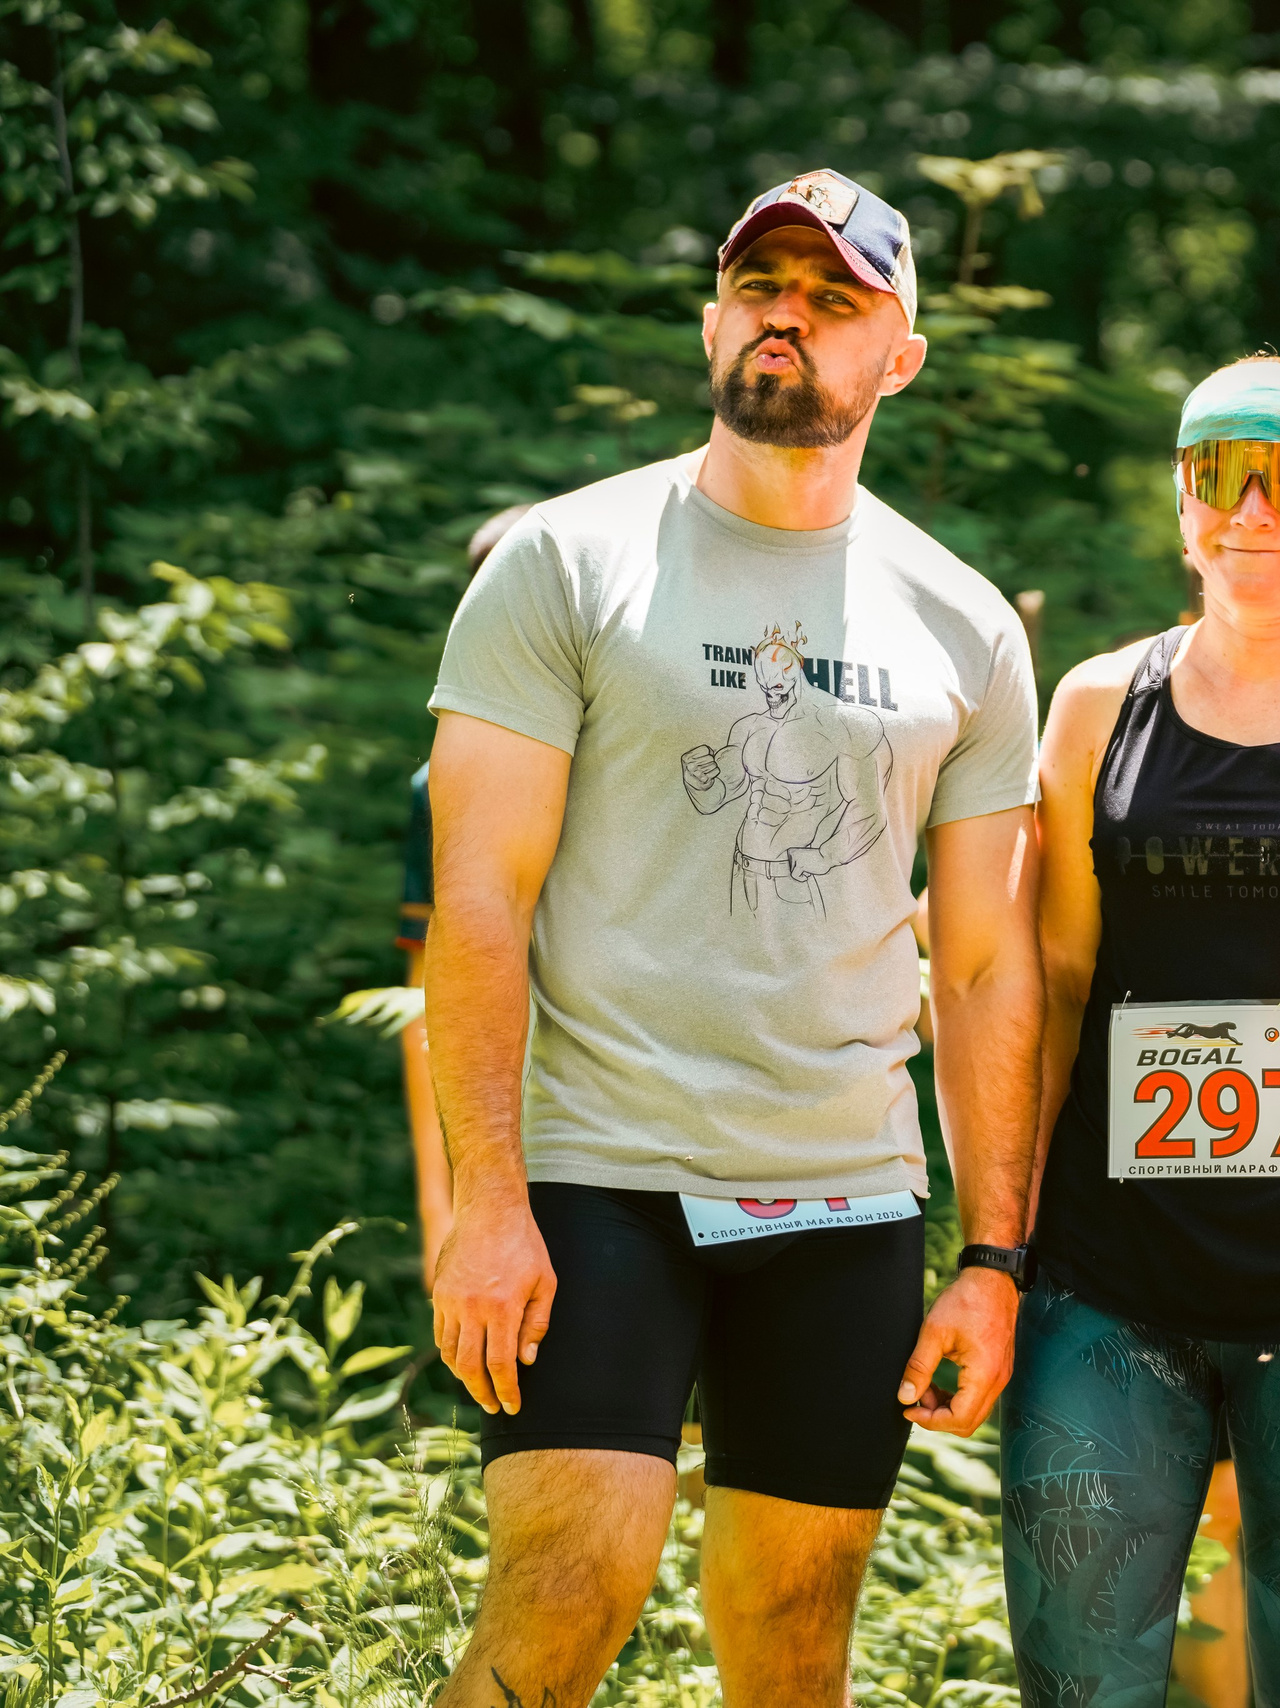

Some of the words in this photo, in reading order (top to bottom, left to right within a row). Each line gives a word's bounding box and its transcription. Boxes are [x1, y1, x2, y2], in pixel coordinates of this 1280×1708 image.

[702, 643, 753, 666] TRAIN
[710, 668, 747, 689] LIKE
[803, 657, 899, 712] HELL
[1196, 822, 1240, 831] SWEAT
[1152, 885, 1213, 899] SMILE
[1136, 1047, 1243, 1067] BOGAL
[1128, 1164, 1223, 1175] СПОРТИВНЫЙ
[711, 1220, 803, 1240] СПОРТИВНЫЙ
[806, 1213, 874, 1227] МАРАФОН
[876, 1210, 904, 1220] 2026
